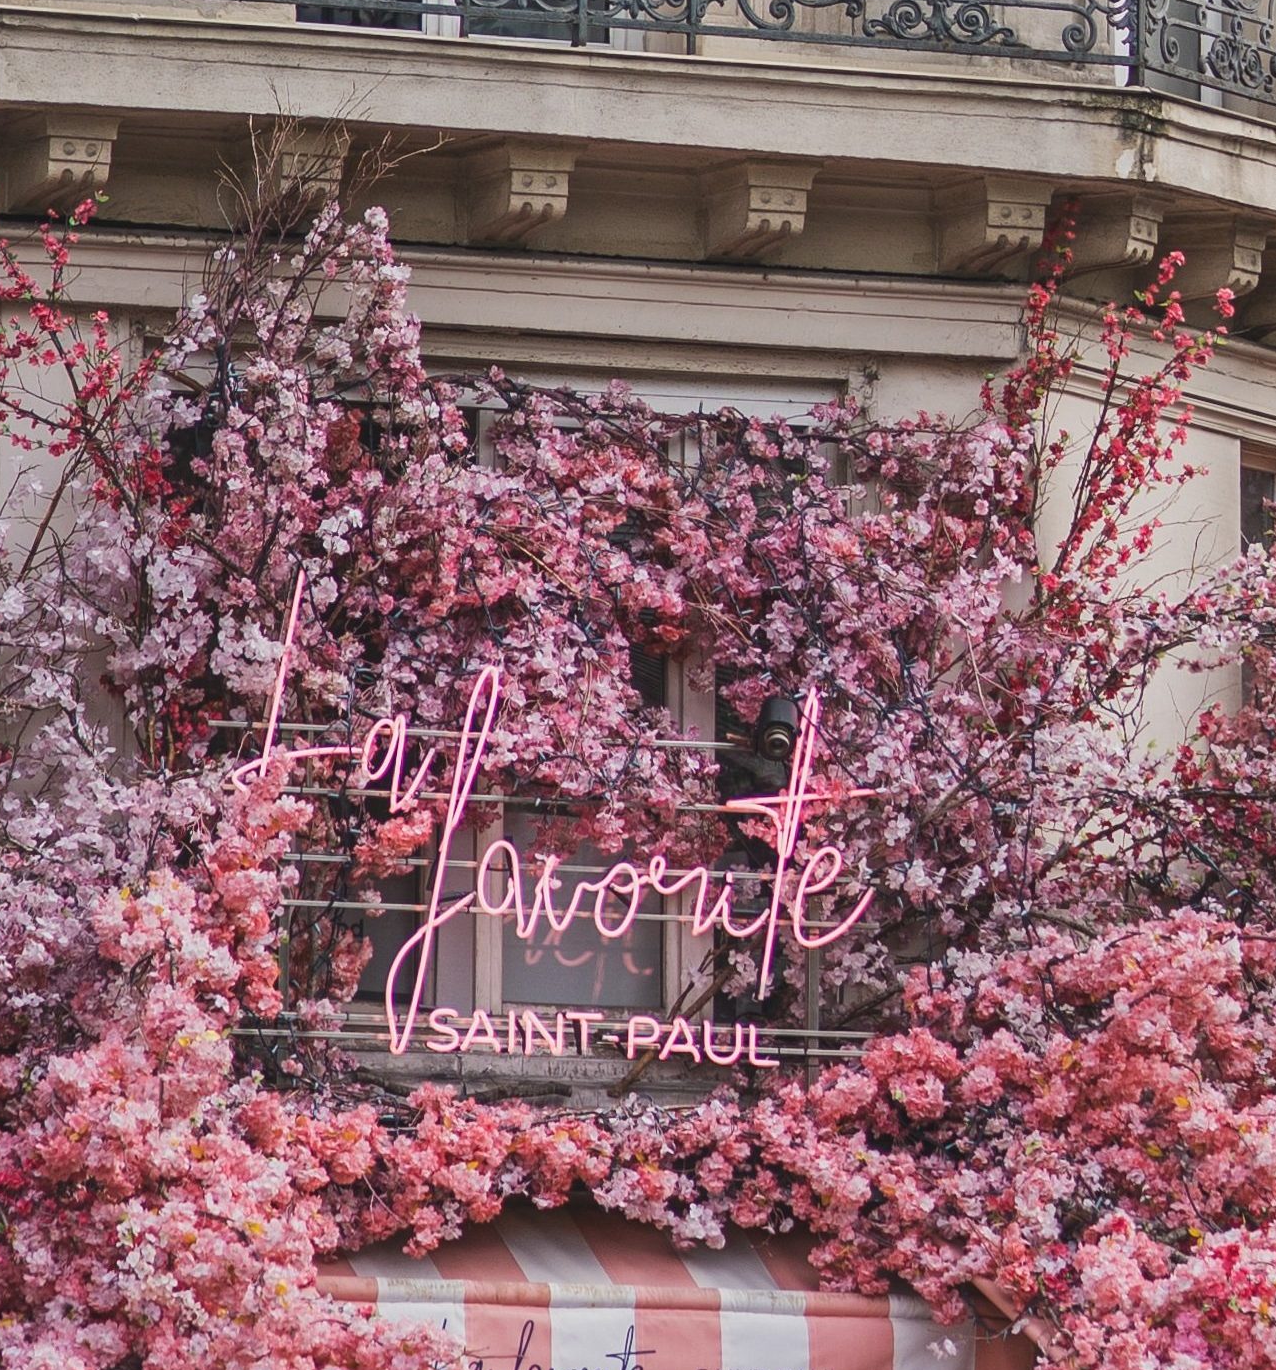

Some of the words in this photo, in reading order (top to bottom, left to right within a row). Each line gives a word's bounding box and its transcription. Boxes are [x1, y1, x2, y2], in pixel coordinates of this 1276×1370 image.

[232, 568, 435, 813] La
[385, 664, 878, 1056] favorite
[425, 1007, 780, 1069] SAINT-PAUL
